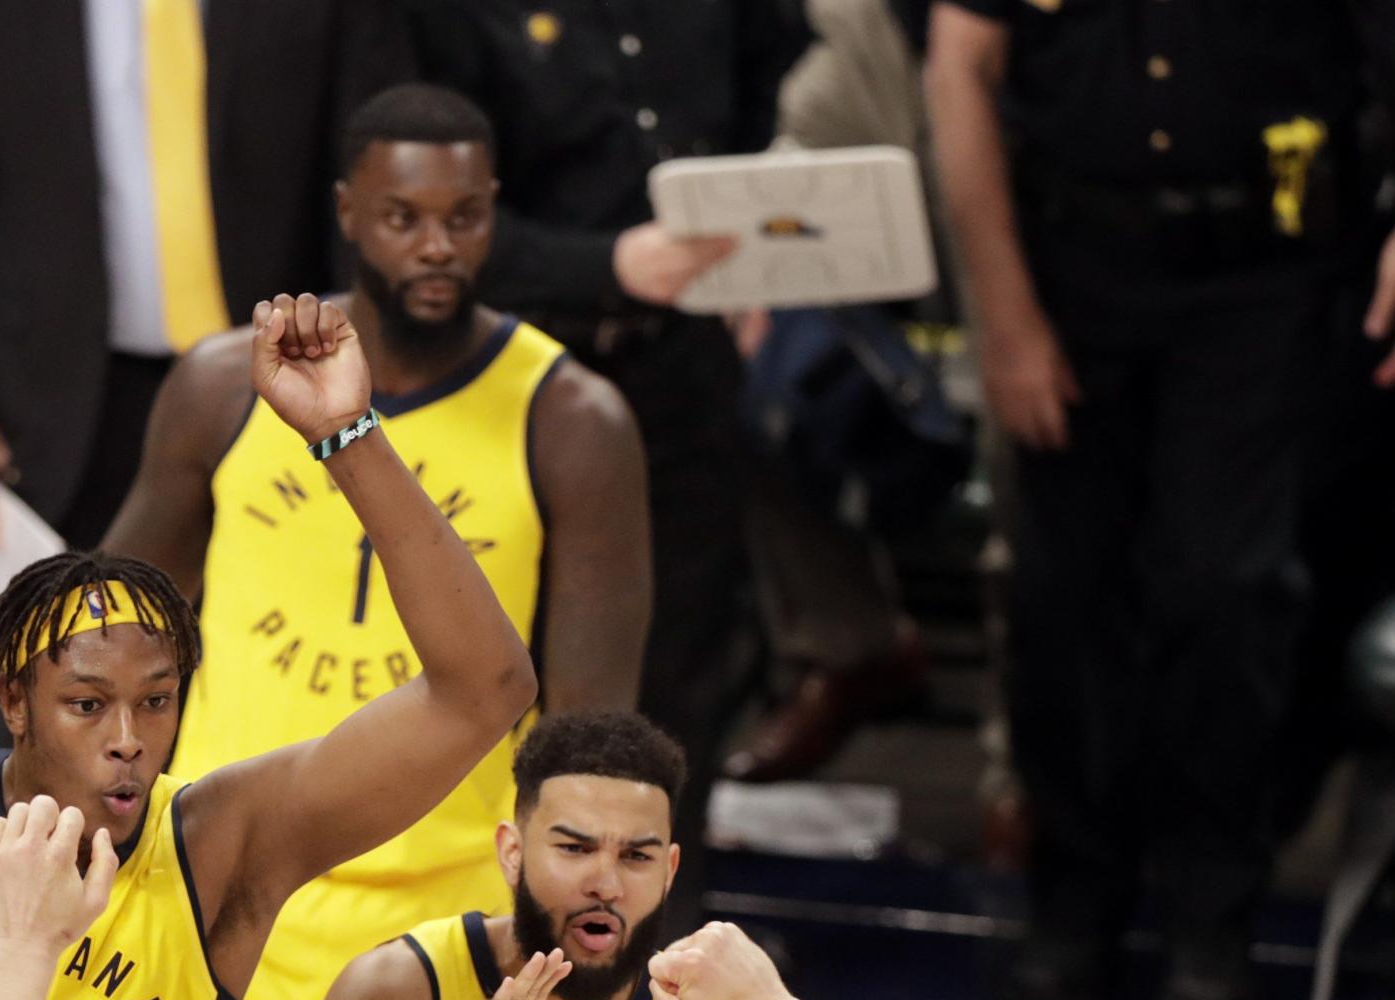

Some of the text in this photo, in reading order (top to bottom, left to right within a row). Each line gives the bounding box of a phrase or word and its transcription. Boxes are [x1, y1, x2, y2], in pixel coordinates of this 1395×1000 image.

[340, 418, 373, 443] deuce
[356, 528, 378, 625] 1
[251, 608, 414, 701] PACER
